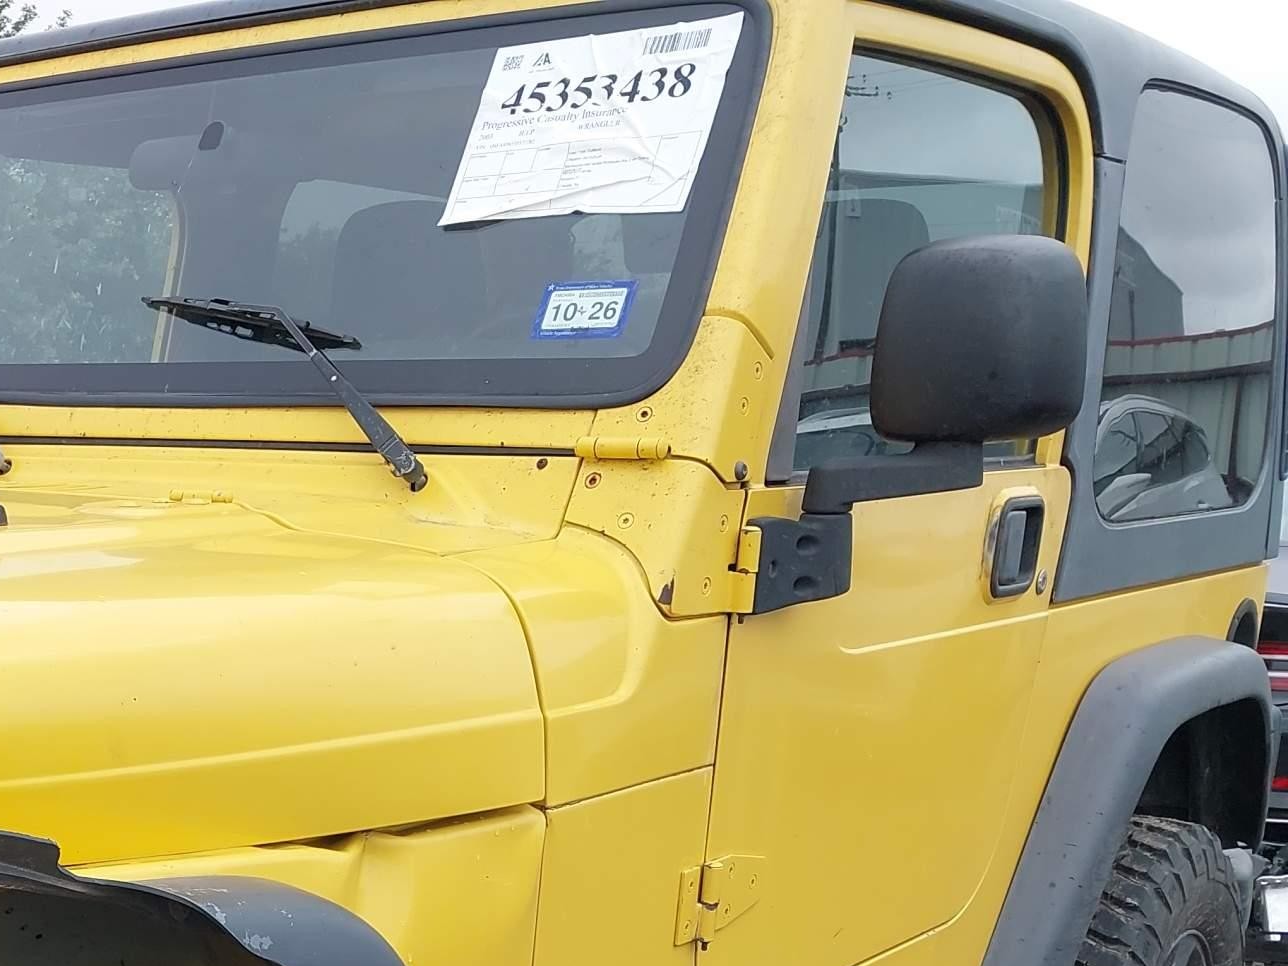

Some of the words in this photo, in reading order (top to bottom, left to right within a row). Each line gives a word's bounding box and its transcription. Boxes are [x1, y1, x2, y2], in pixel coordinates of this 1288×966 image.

[501, 63, 696, 115] 45353438
[482, 116, 535, 131] Progressive
[537, 110, 580, 124] Casualty
[551, 302, 578, 322] 10
[588, 300, 619, 321] 26
